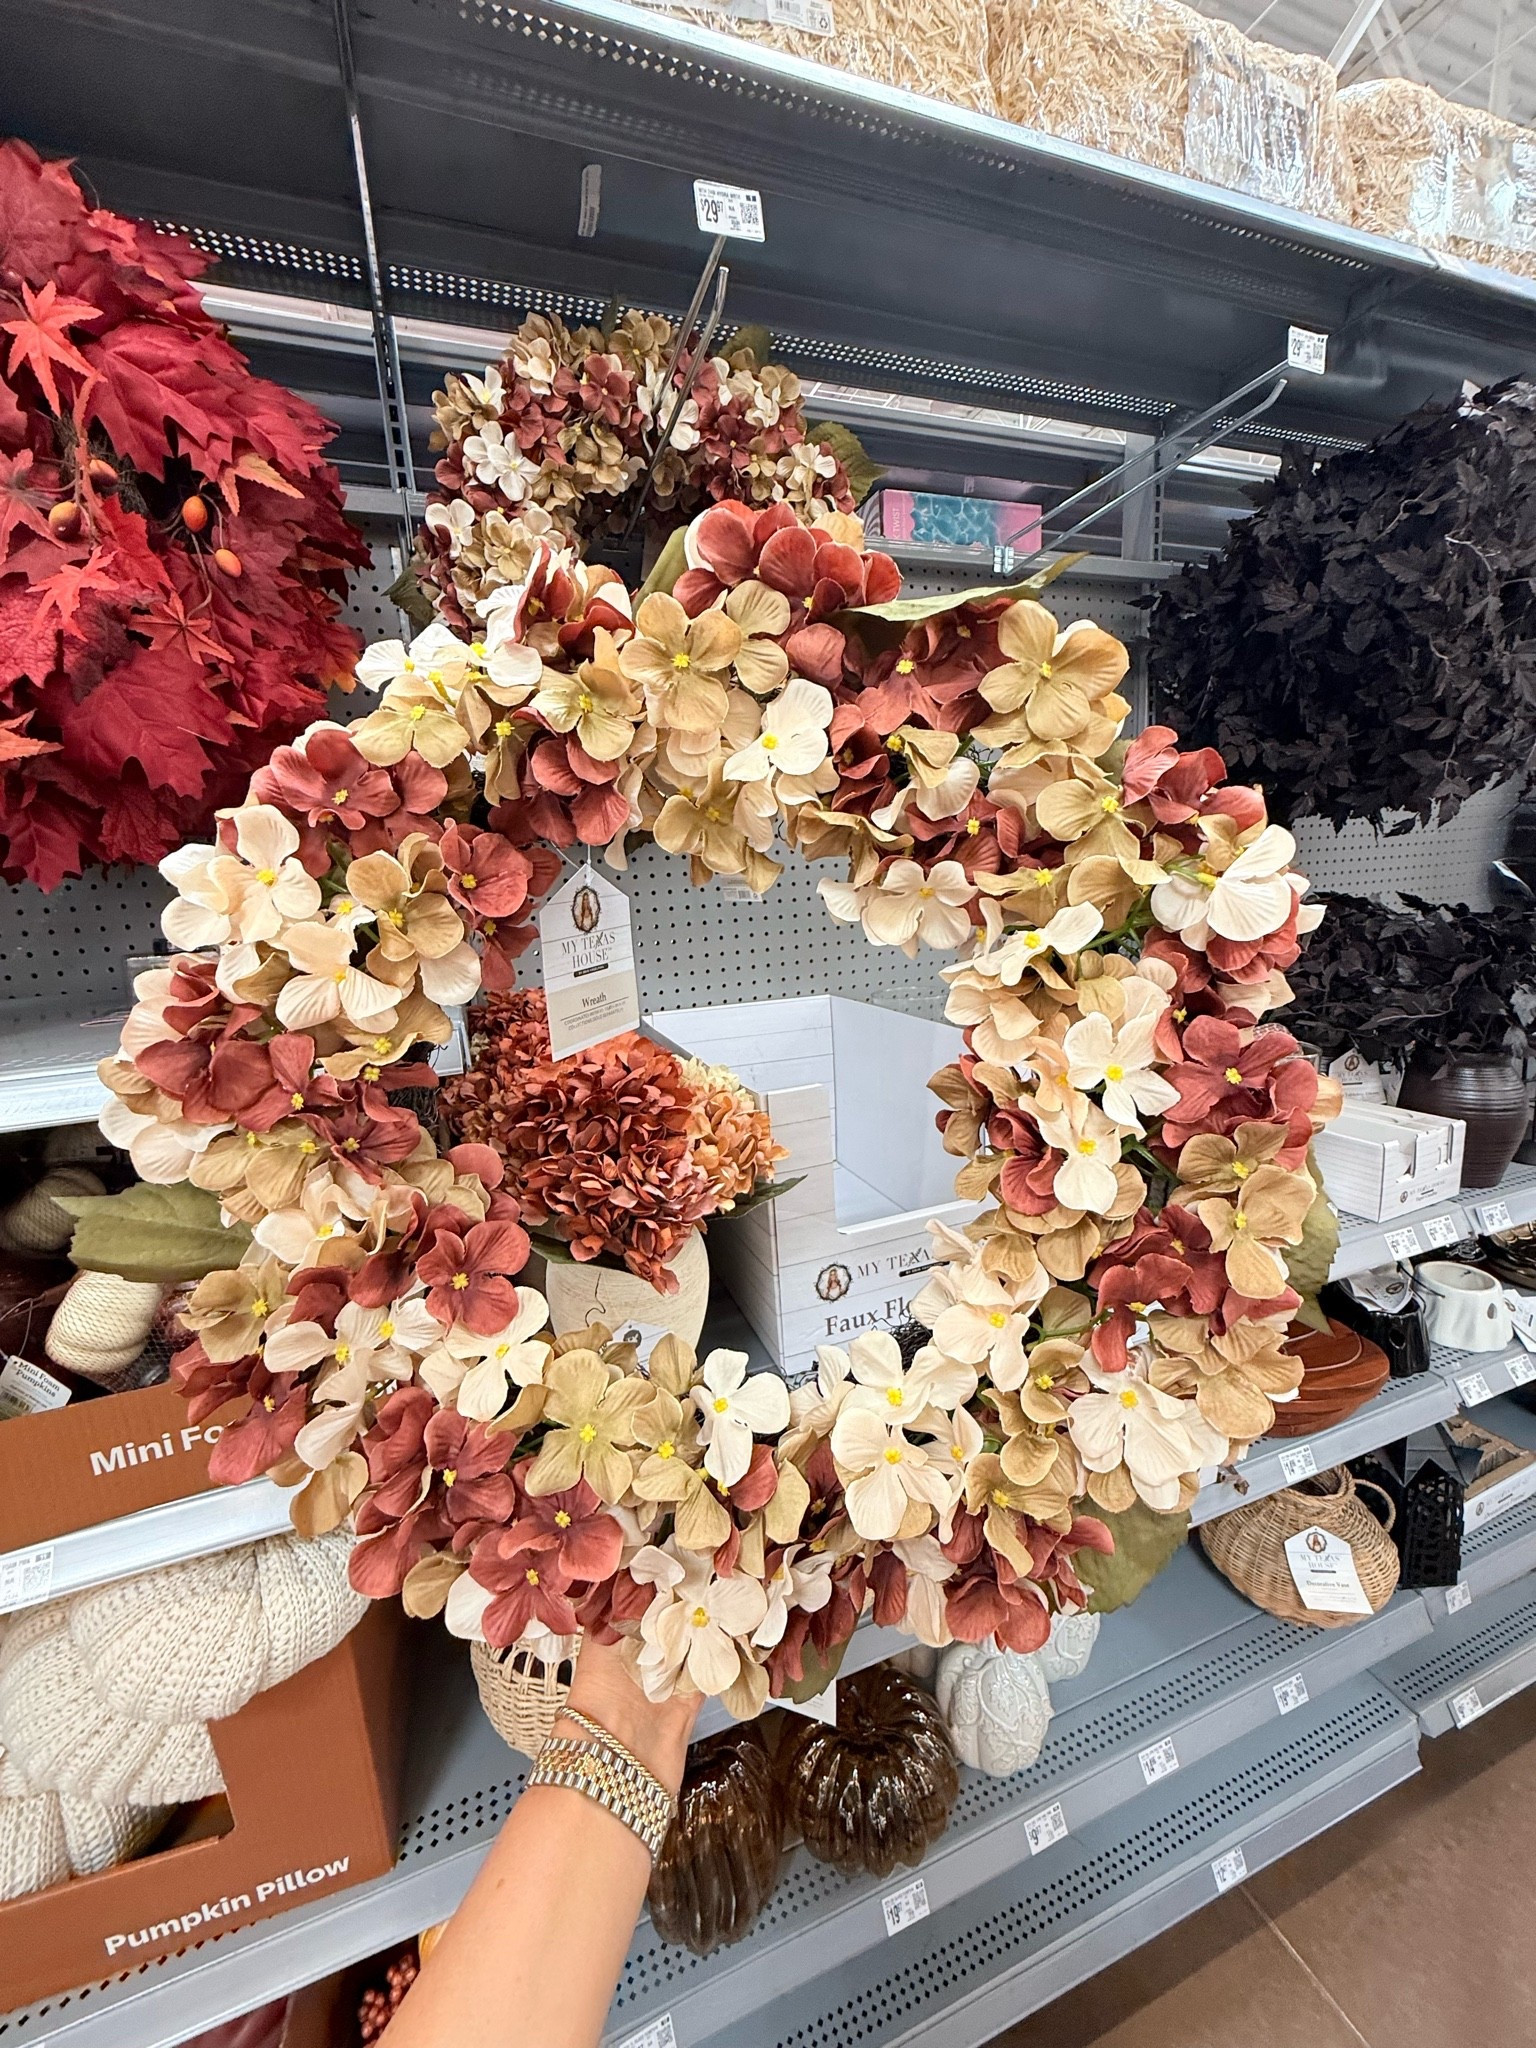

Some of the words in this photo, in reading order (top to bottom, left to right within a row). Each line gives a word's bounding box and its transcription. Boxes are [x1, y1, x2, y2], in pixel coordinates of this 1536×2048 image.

[561, 940, 577, 955] MY
[581, 931, 616, 950] TEXAS
[572, 949, 609, 969] HOUSE
[582, 992, 607, 1008] Wreath
[857, 1259, 880, 1279] MY
[886, 1247, 934, 1270] TEXA
[825, 1309, 878, 1337] Faux
[16, 1369, 56, 1398] Pumpkins
[19, 1362, 39, 1377] Mini
[40, 1373, 60, 1392] Foam
[89, 1432, 174, 1476] Mini
[180, 1424, 225, 1452] Fo
[104, 1896, 251, 1956] Pumpkin
[255, 1856, 350, 1903] Pillow
